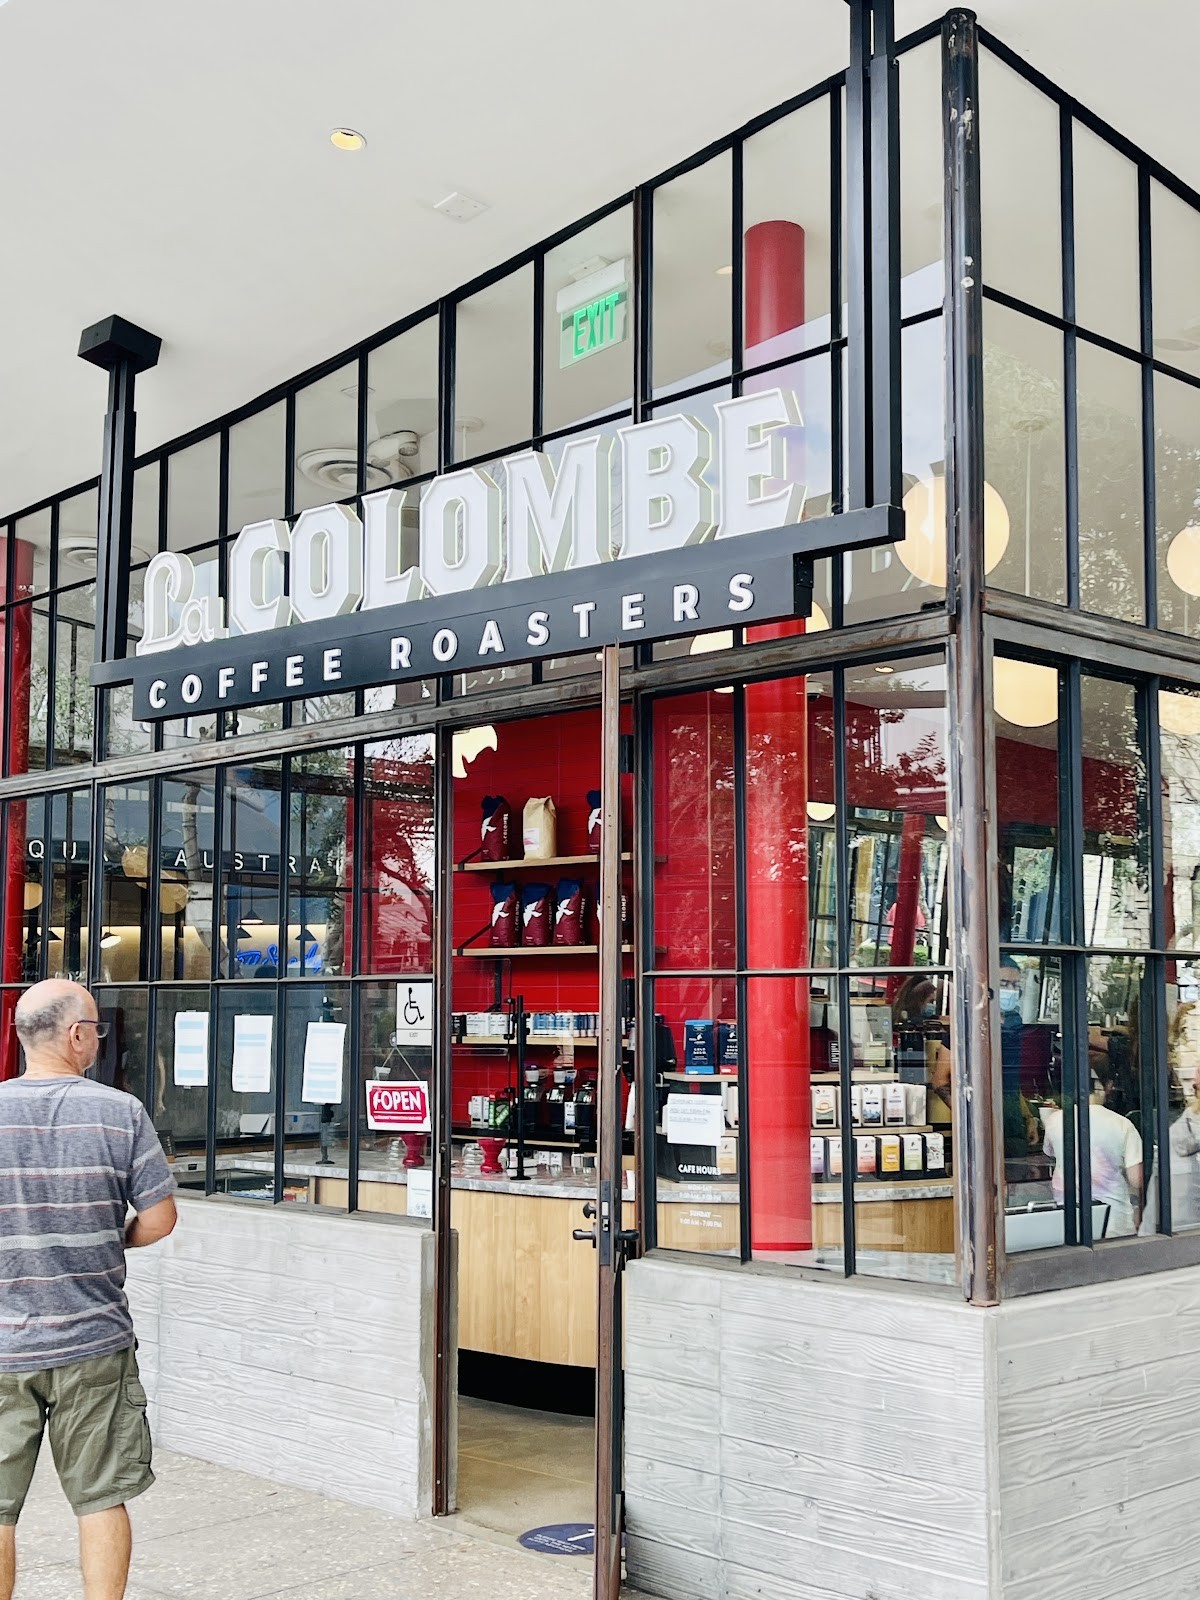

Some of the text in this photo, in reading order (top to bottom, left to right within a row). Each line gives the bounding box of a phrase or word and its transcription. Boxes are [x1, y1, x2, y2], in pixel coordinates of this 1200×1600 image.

[573, 292, 619, 358] EXIT
[136, 388, 807, 656] La COLOMBE
[149, 574, 756, 709] COFFEE ROASTERS
[28, 839, 138, 863] QU
[381, 1090, 422, 1111] OPEN
[678, 1163, 722, 1176] CAFE HOURS
[689, 1210, 712, 1219] SUNDAY
